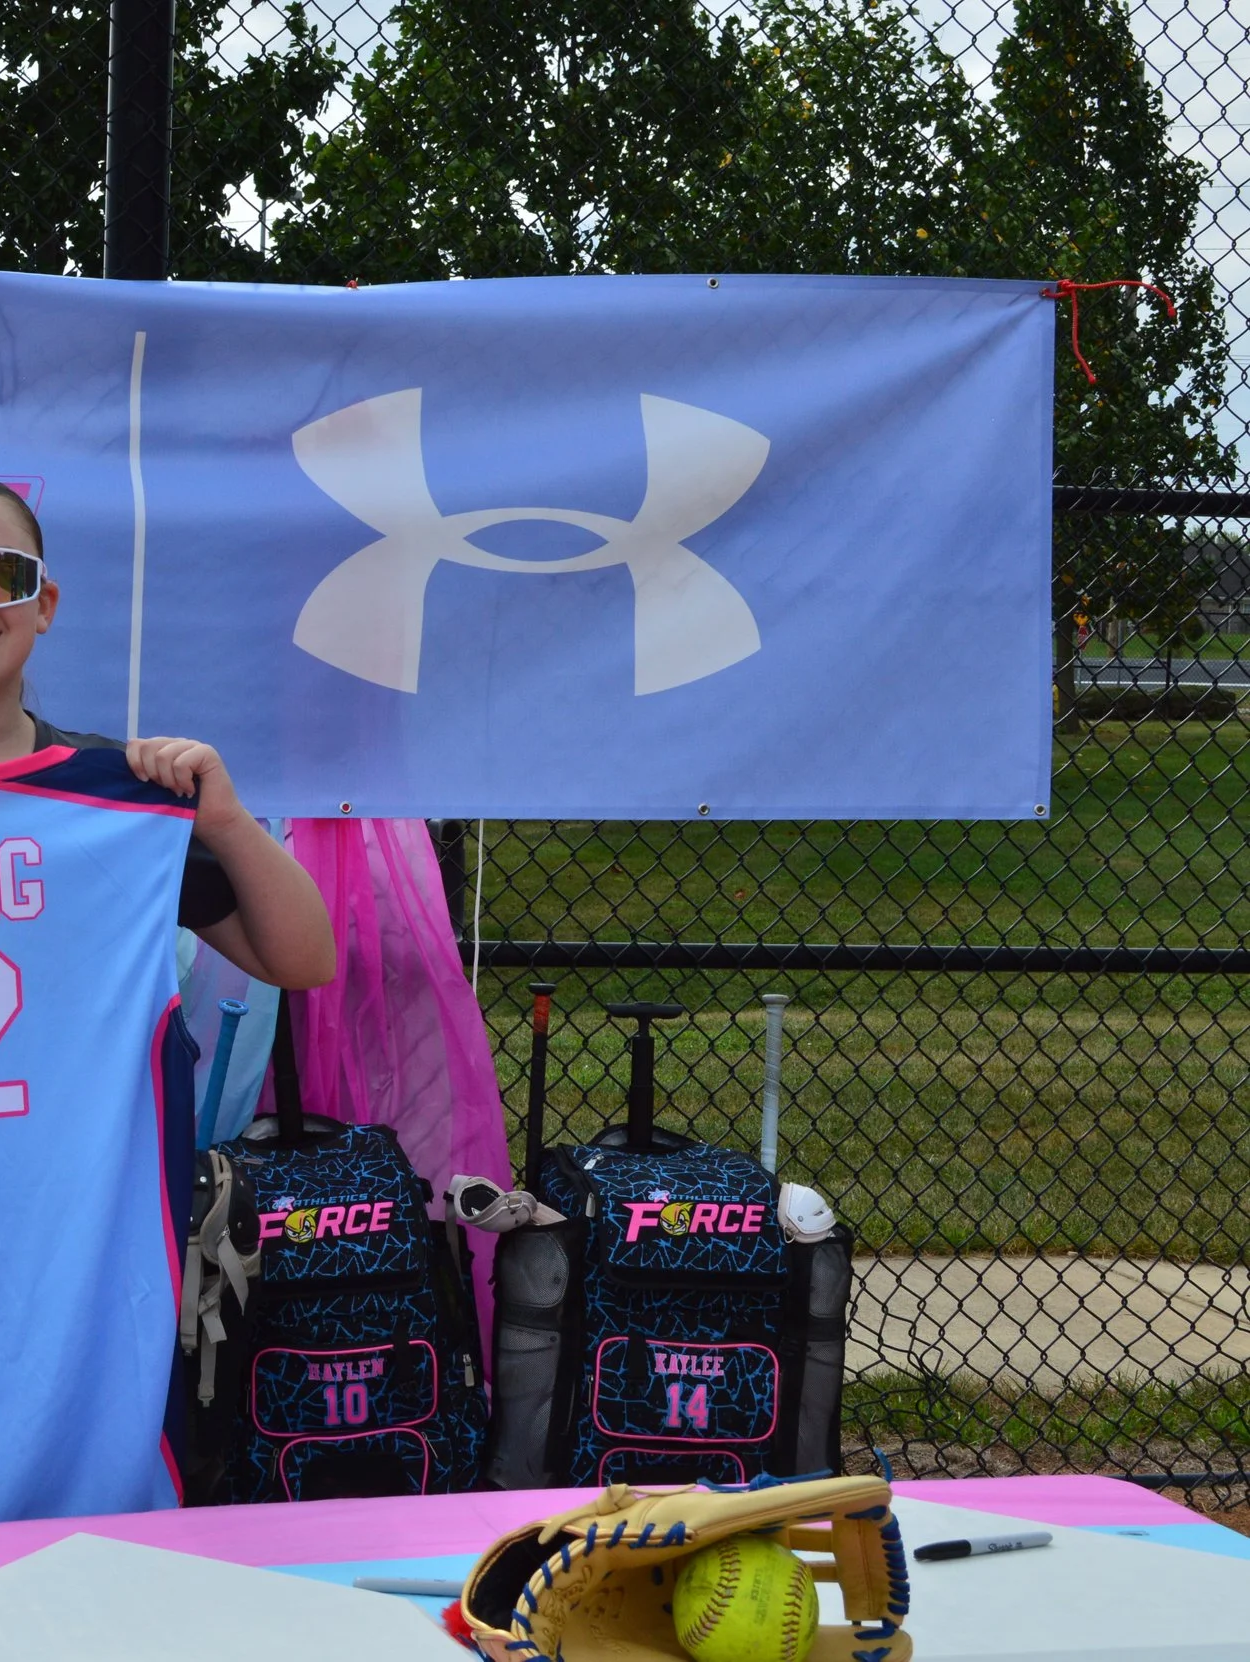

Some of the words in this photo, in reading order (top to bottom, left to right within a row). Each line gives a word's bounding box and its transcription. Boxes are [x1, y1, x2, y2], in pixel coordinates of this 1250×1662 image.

[293, 1192, 369, 1207] ATHLETICS
[668, 1193, 741, 1202] ATHLETICS
[258, 1201, 394, 1249] FORCE
[622, 1200, 765, 1242] FORCE
[654, 1352, 725, 1376] KAYLEE
[323, 1383, 369, 1426] 10
[665, 1382, 710, 1429] 14
